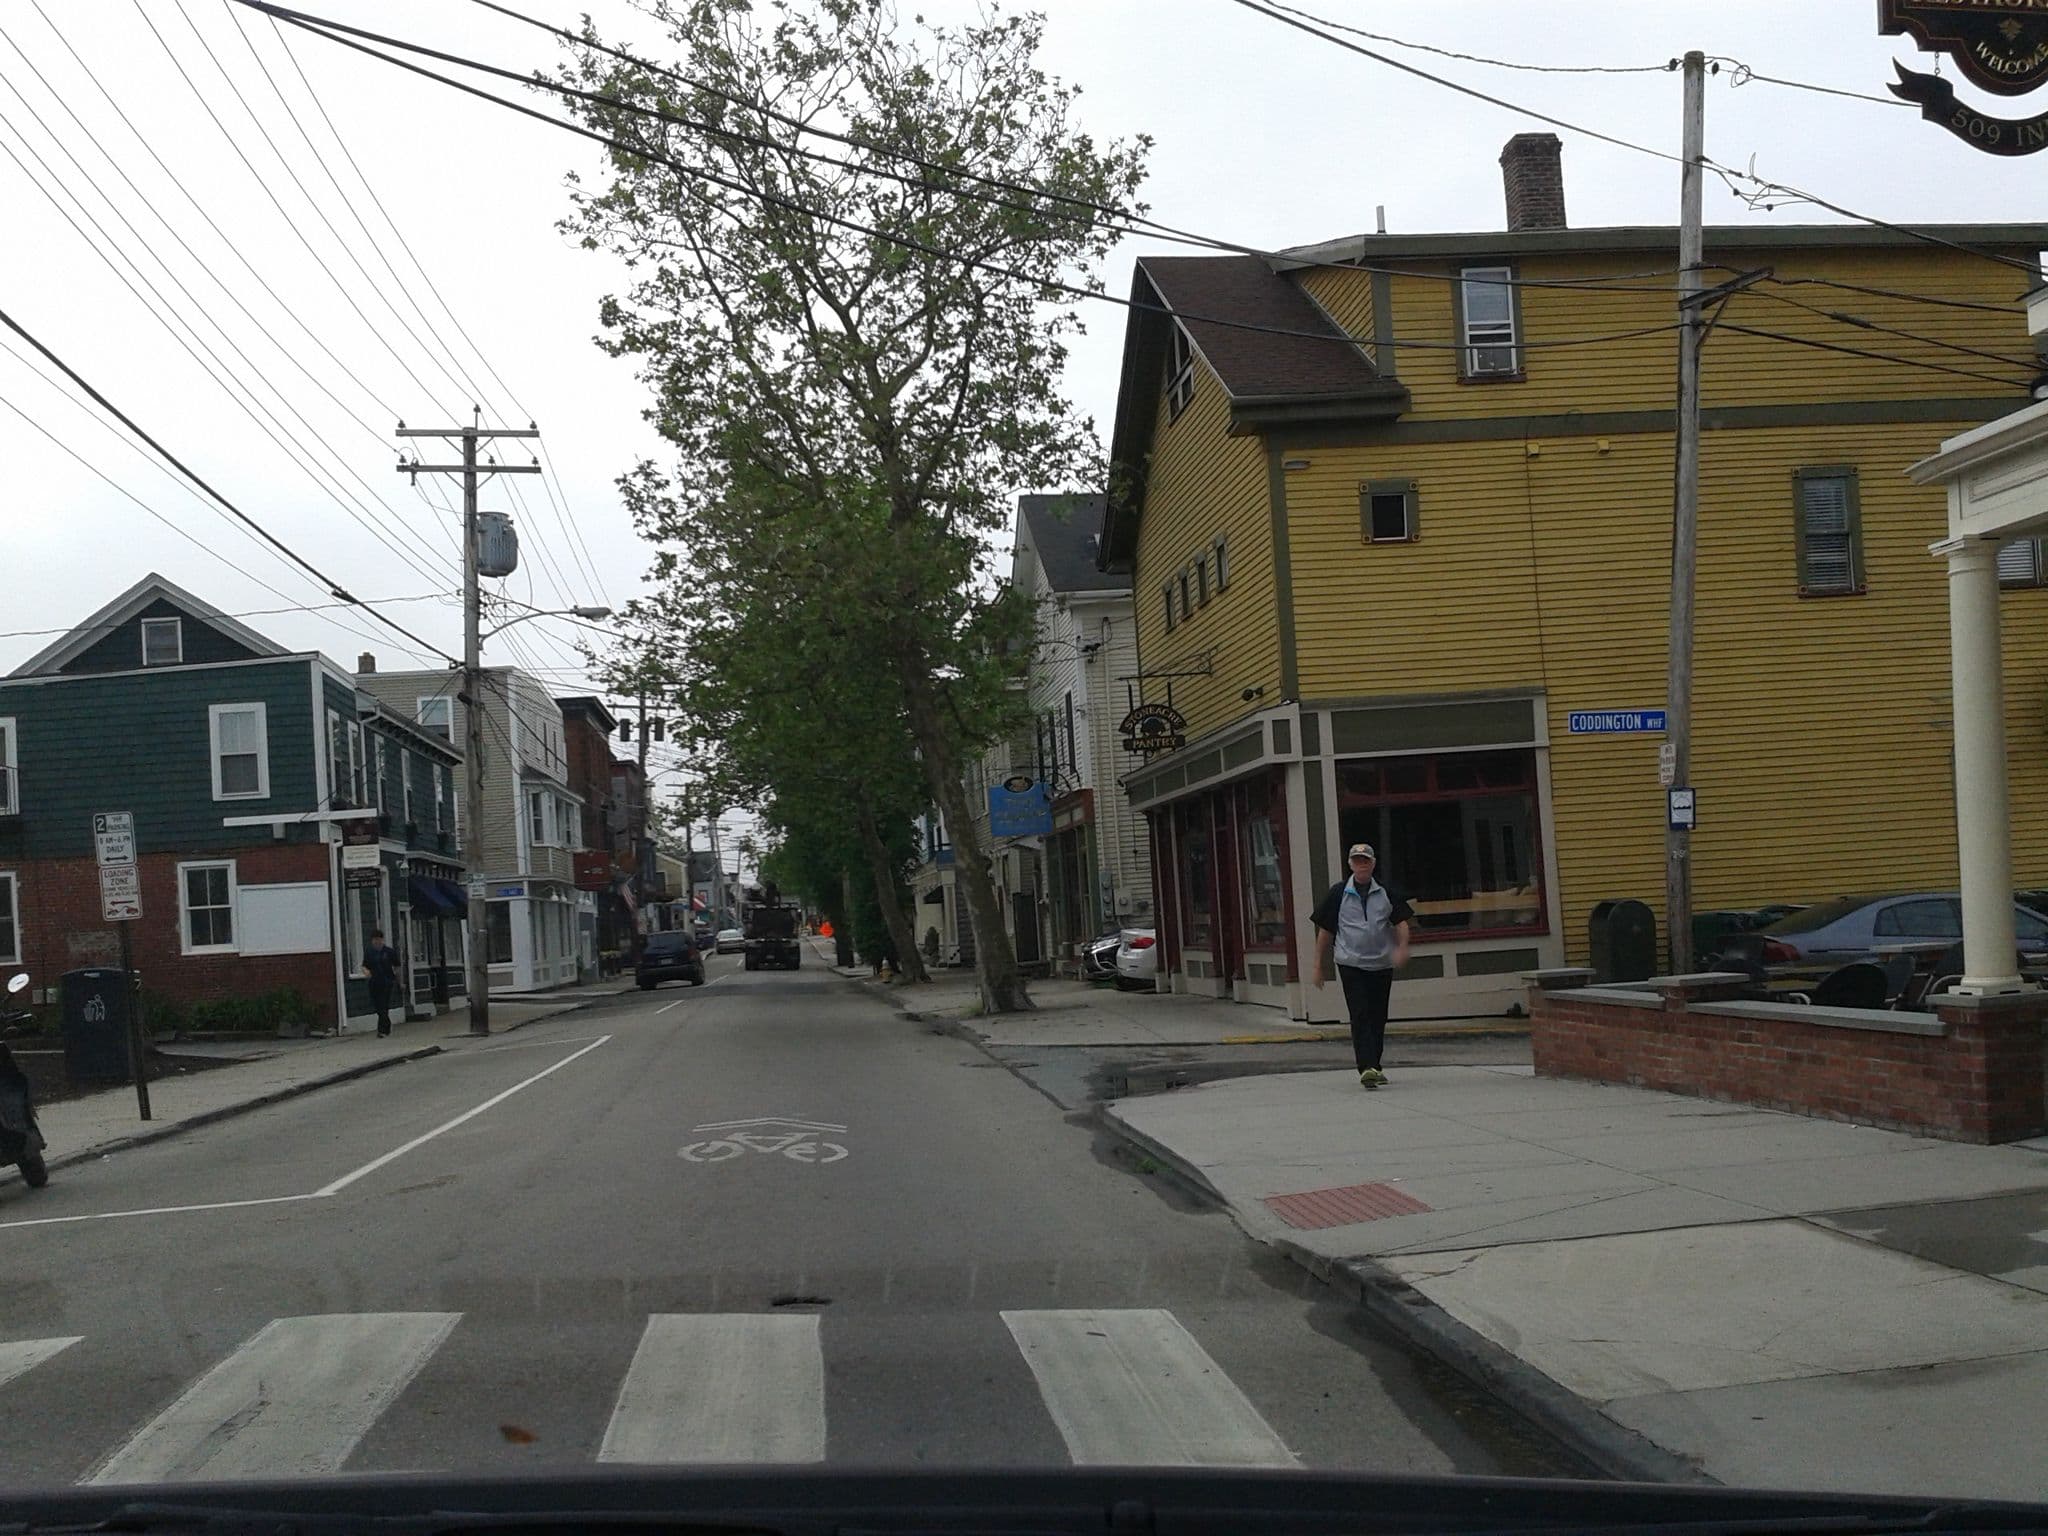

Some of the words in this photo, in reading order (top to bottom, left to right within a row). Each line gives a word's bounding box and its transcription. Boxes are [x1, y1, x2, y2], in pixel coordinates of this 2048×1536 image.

[1951, 108, 2000, 145] 509
[2016, 119, 2048, 147] IN
[1572, 714, 1641, 731] CODDINGTON
[1647, 717, 1664, 729] WHF
[1133, 737, 1177, 748] PANTRY
[96, 817, 105, 831] 2
[107, 844, 124, 853] DAILY
[104, 868, 134, 878] LOADING
[110, 878, 129, 886] ZONE
